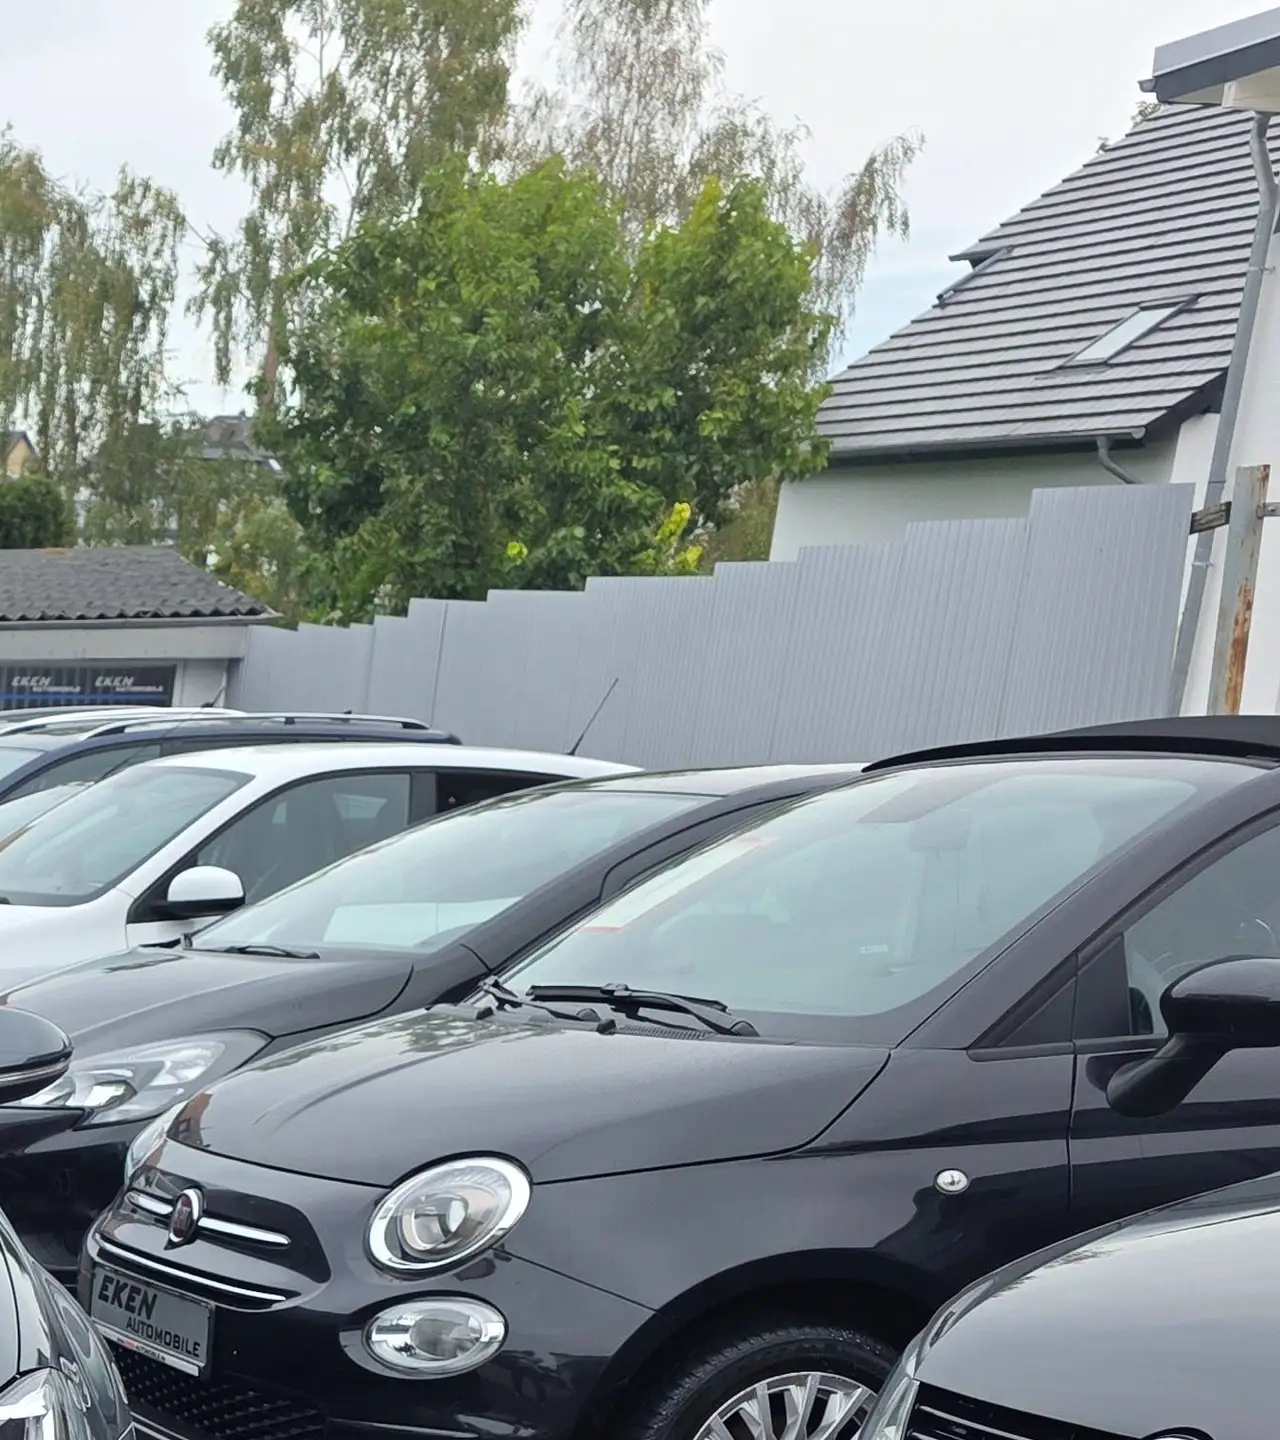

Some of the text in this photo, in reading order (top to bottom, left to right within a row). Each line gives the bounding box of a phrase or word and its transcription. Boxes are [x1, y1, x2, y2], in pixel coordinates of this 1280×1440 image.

[10, 675, 52, 686] EKEN
[94, 675, 135, 686] EKEN
[98, 1274, 158, 1320] EKEN
[126, 1316, 201, 1358] AUTOMOBILE
